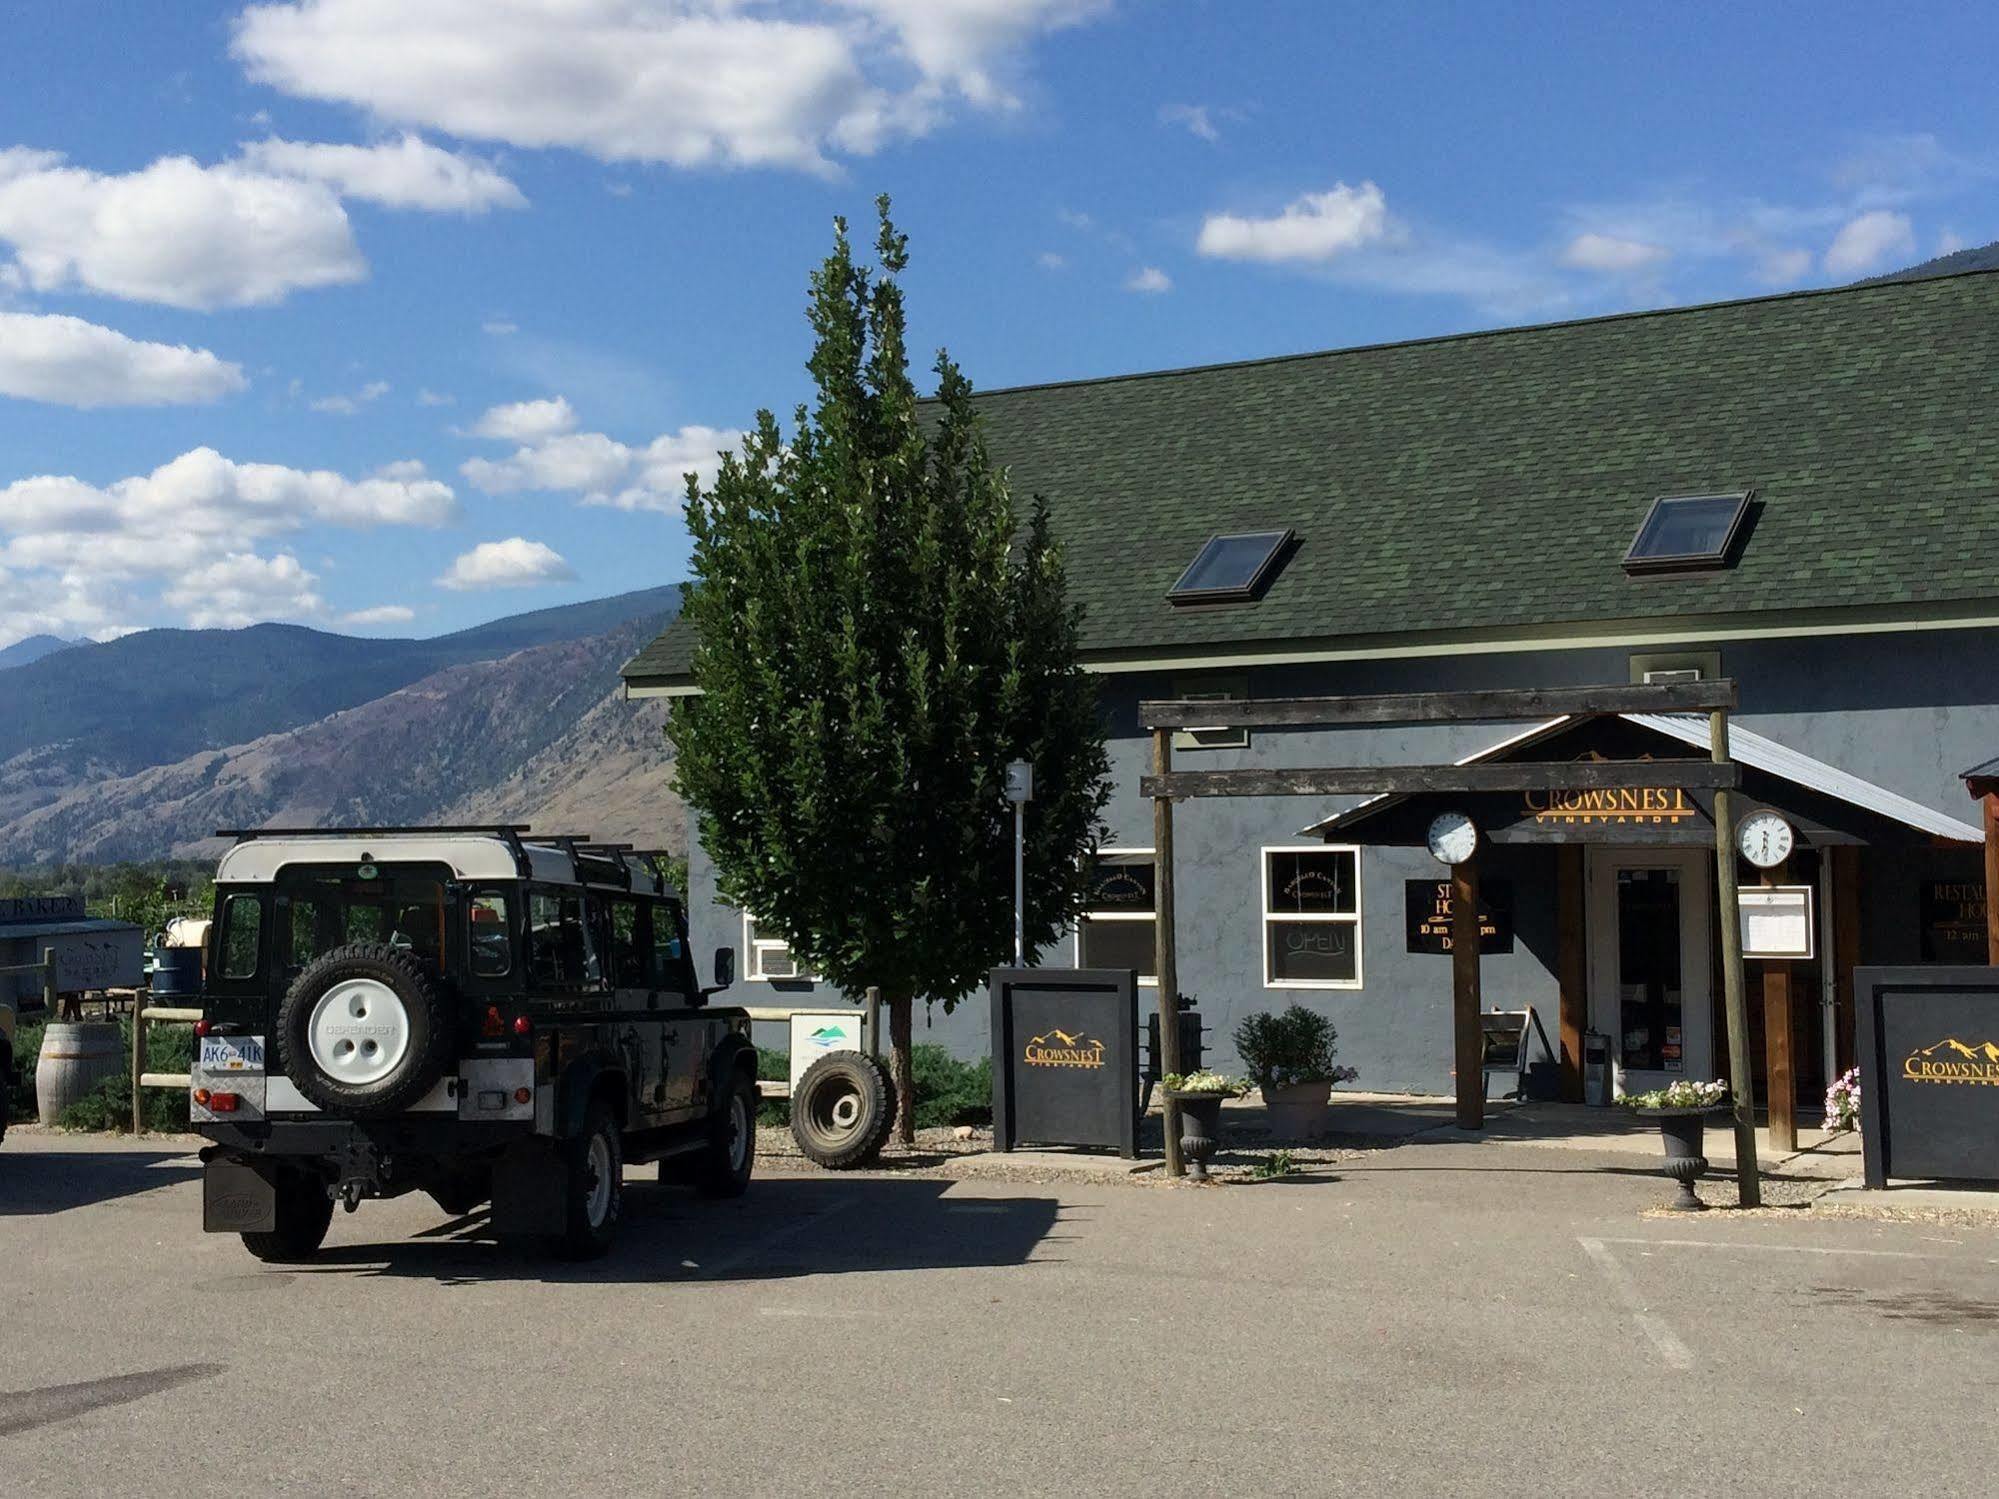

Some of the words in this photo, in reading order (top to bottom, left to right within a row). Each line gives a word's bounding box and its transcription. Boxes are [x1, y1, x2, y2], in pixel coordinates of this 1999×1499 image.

[1524, 789, 1685, 810] CROWSNEST
[1536, 816, 1679, 824] VINEYARDS
[1480, 926, 1496, 936] pm
[1286, 931, 1345, 951] OPEN
[203, 1045, 229, 1062] AK6
[238, 1045, 263, 1061] 41K
[1025, 1044, 1101, 1062] CROWSNEST
